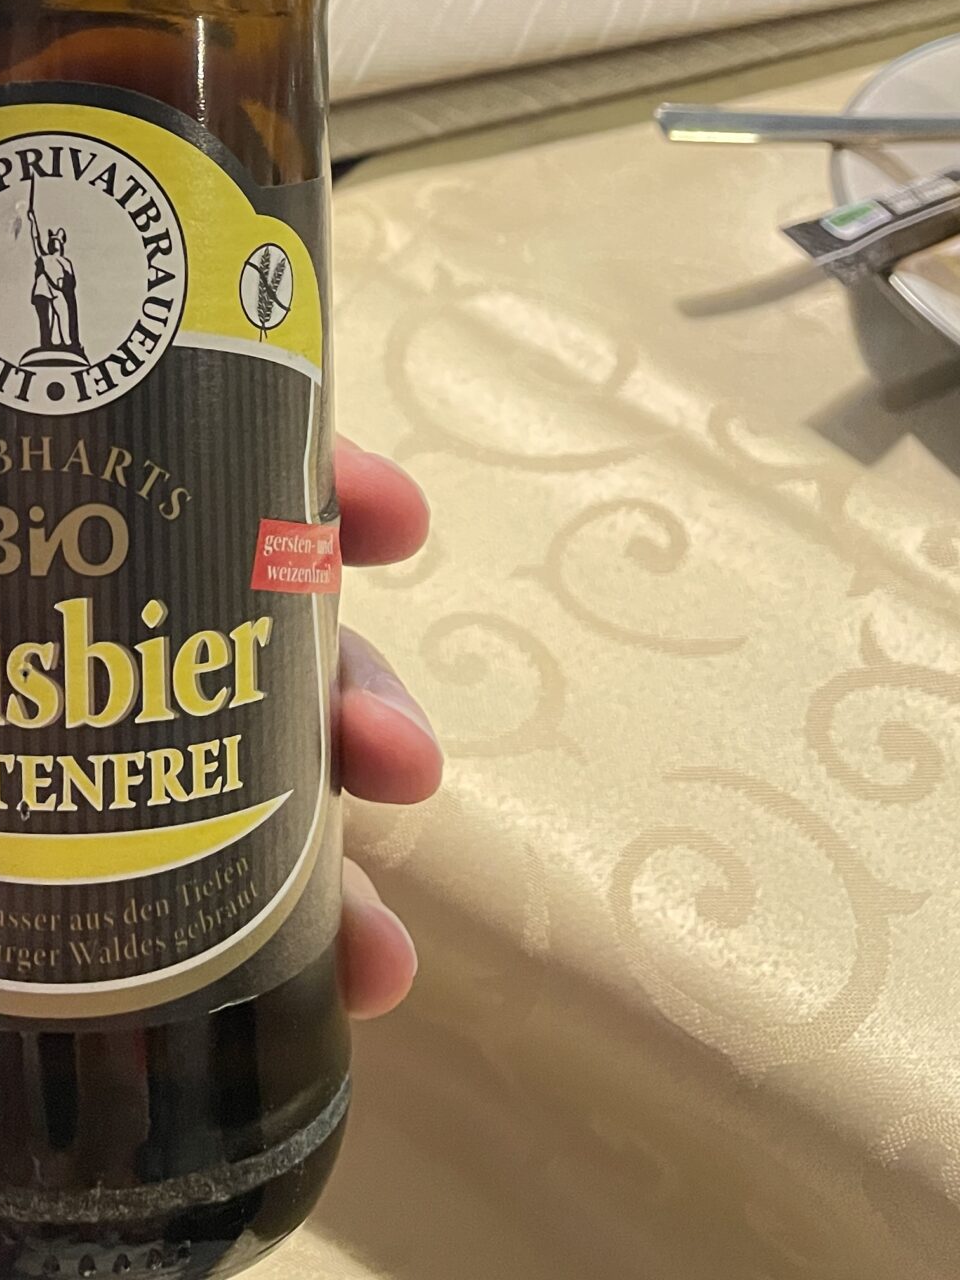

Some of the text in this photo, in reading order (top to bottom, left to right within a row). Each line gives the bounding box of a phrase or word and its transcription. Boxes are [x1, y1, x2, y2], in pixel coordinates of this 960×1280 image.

[69, 910, 115, 931] aus
[123, 897, 169, 925] den
[69, 933, 166, 966] Waldes
[174, 881, 259, 954] gebraut
